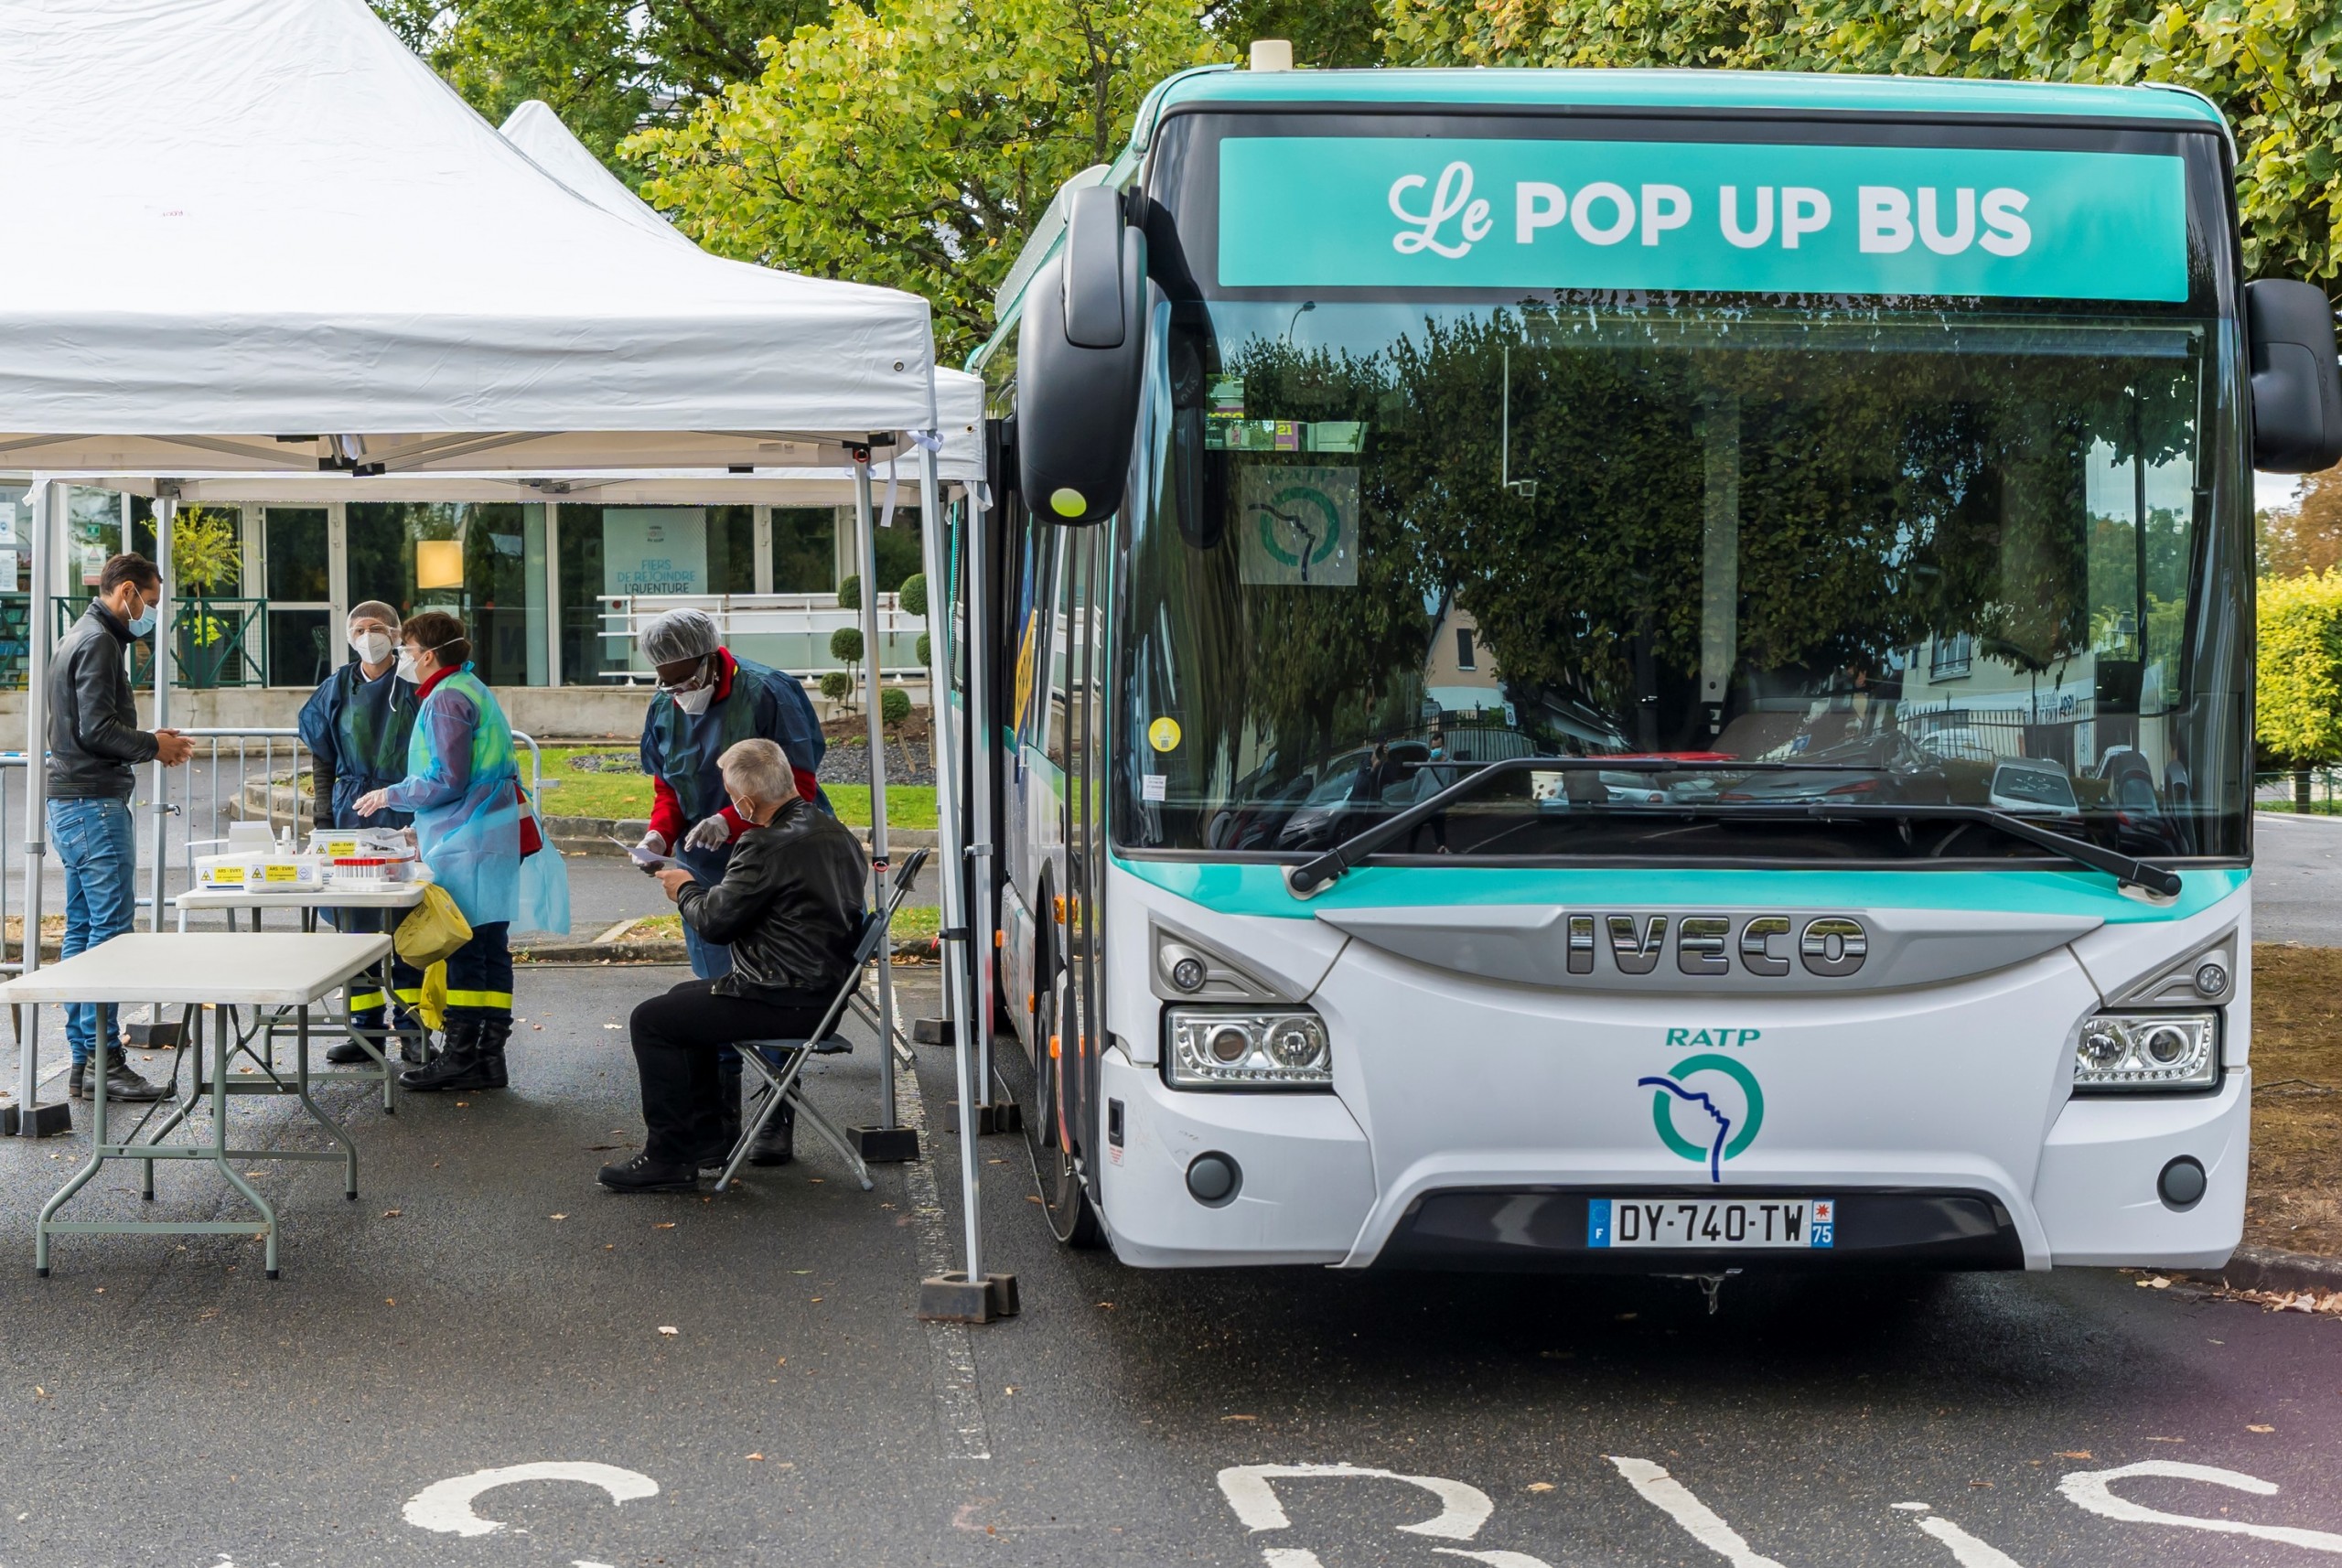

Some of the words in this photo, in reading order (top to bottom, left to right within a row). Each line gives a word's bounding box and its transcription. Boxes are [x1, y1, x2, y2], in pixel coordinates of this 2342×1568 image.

[1388, 160, 1494, 259] Le
[1516, 181, 1693, 247] POP
[1719, 185, 1832, 251] UP
[1858, 185, 2033, 258] BUS
[641, 559, 671, 570] FIERS
[618, 572, 630, 583] DE
[634, 571, 695, 583] REJOINDRE
[625, 583, 689, 594] L'AVENTURE
[1566, 914, 1868, 978] IVECO
[1665, 1027, 1761, 1047] RATP
[1595, 1228, 1604, 1240] F
[1618, 1204, 1804, 1242] DY-740-TW
[1813, 1225, 1832, 1244] 75
